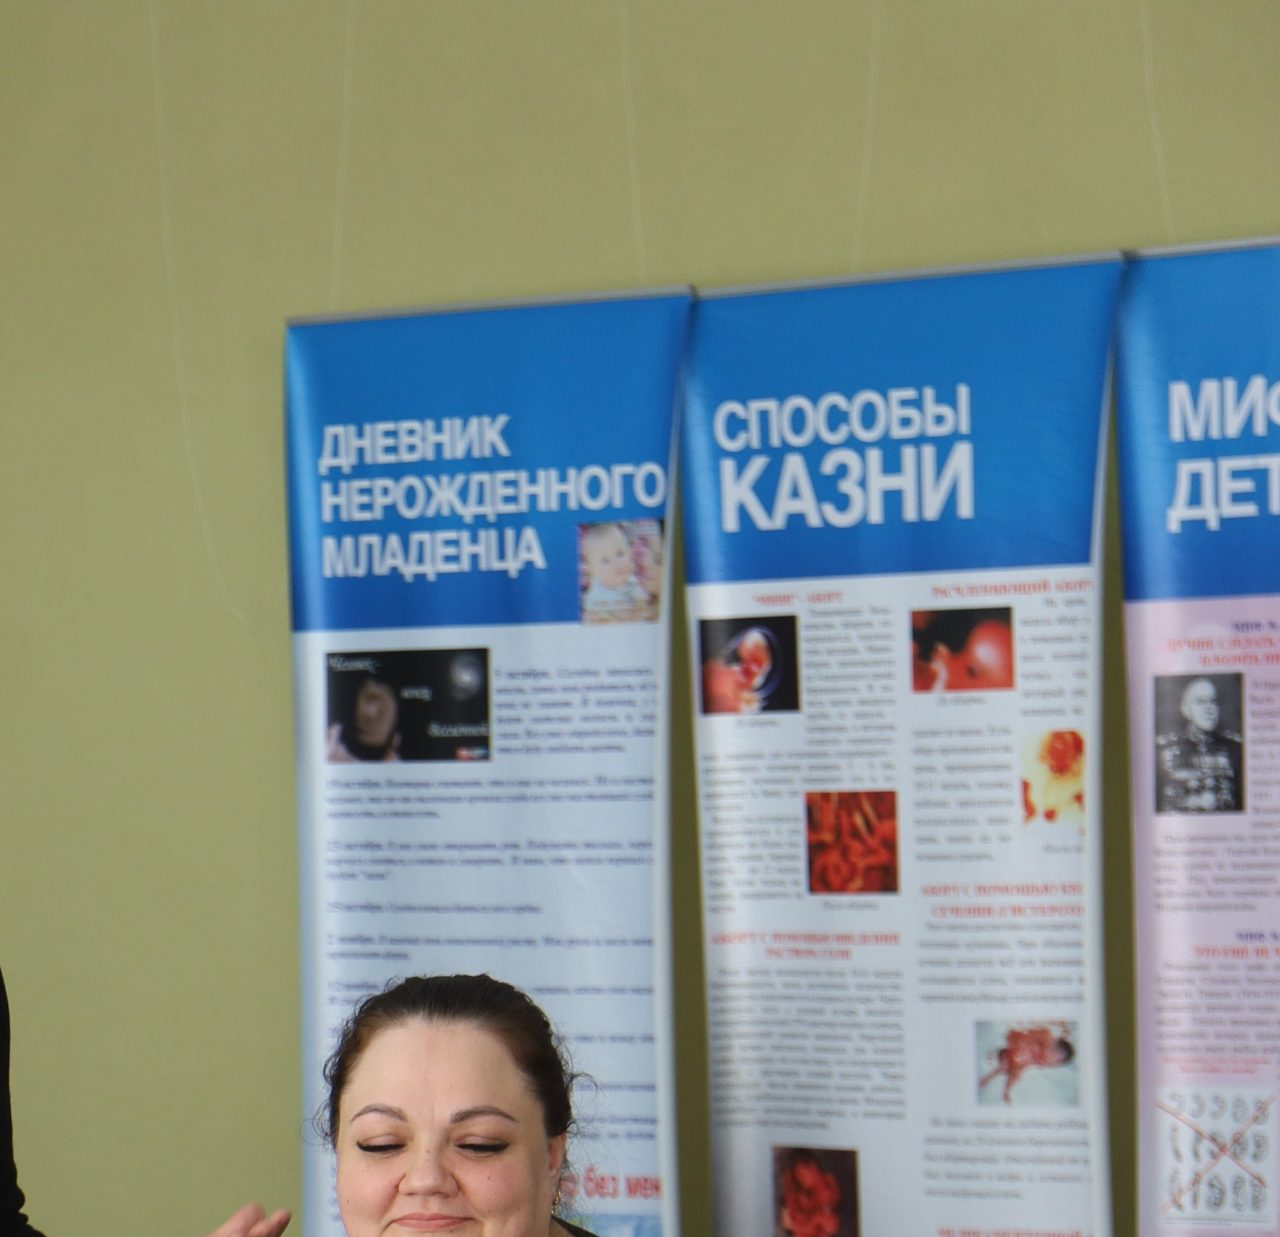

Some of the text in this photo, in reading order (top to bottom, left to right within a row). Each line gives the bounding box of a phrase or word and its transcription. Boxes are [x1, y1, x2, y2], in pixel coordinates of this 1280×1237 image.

[317, 413, 511, 476] ДНЕВНИК
[713, 382, 971, 453] СПОСОБЫ
[321, 461, 666, 524] НЕРОЖДЕННОГО
[721, 440, 975, 533] КАЗНИ
[322, 527, 548, 583] МЛАДЕНЦА
